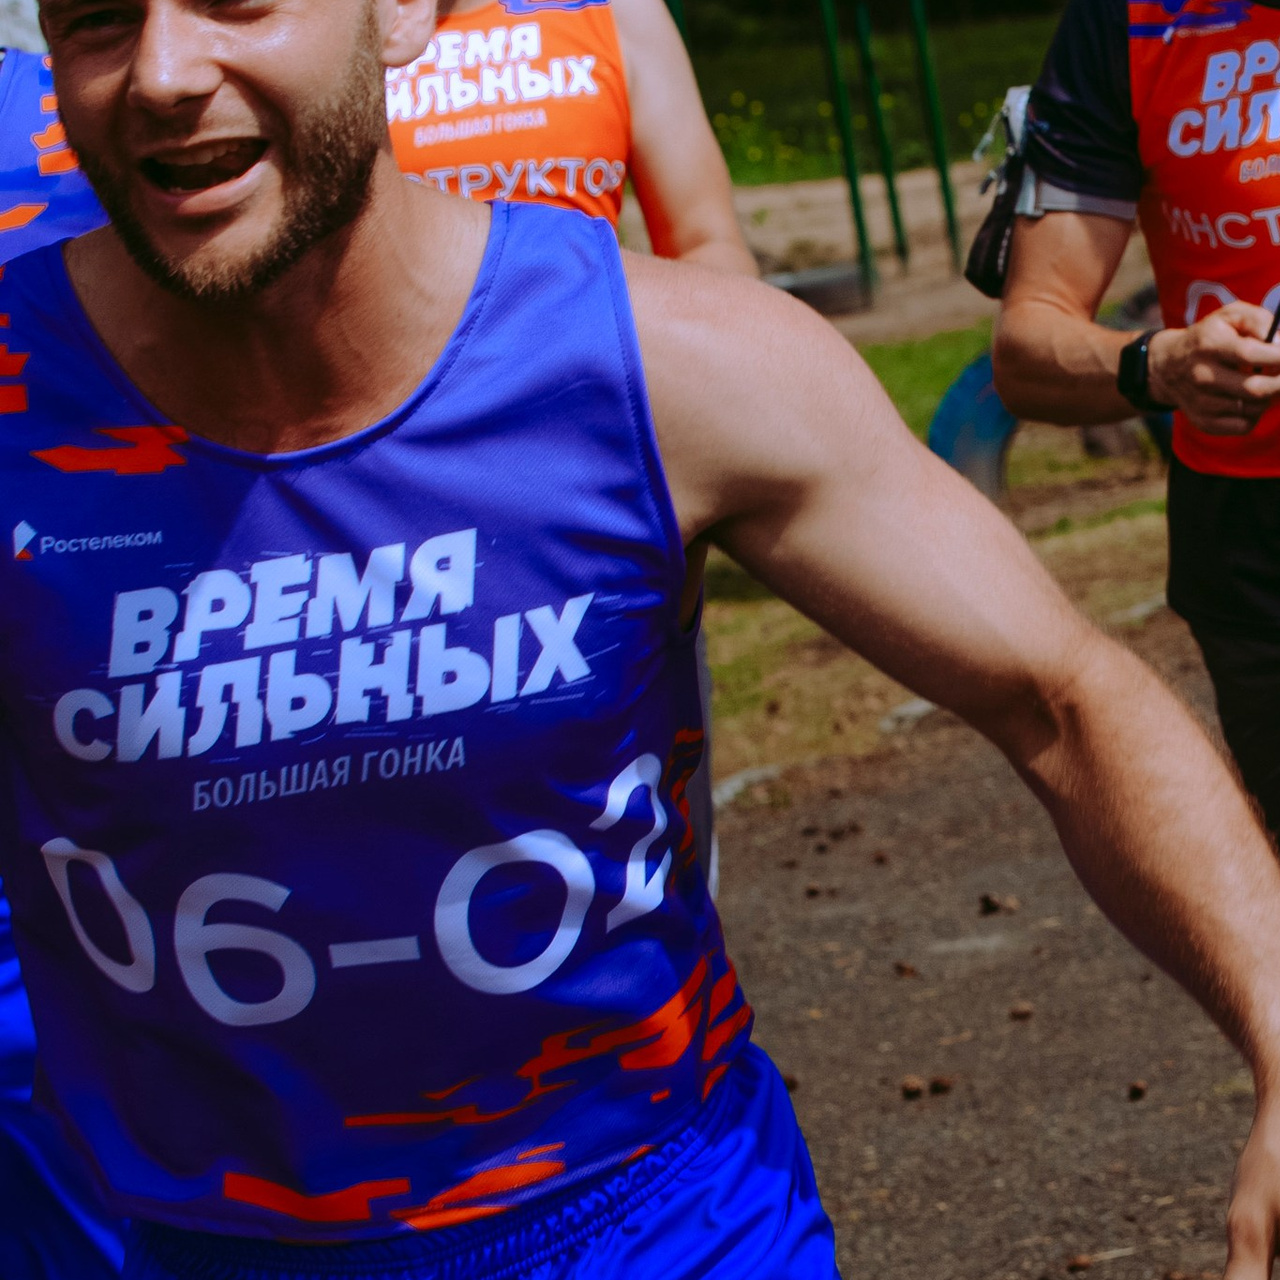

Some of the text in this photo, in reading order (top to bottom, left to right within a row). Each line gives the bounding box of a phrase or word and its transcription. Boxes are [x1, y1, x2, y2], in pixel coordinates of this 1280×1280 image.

[385, 56, 598, 122] ИЛЬНЫХ
[40, 530, 163, 555] Ростелеком
[108, 527, 478, 679] ВРЕМЯ
[53, 592, 596, 763] СИЛЬНЫХ
[192, 736, 467, 812] БОЛЬШАЯ ГОНКА
[40, 752, 673, 1027] 06-02
